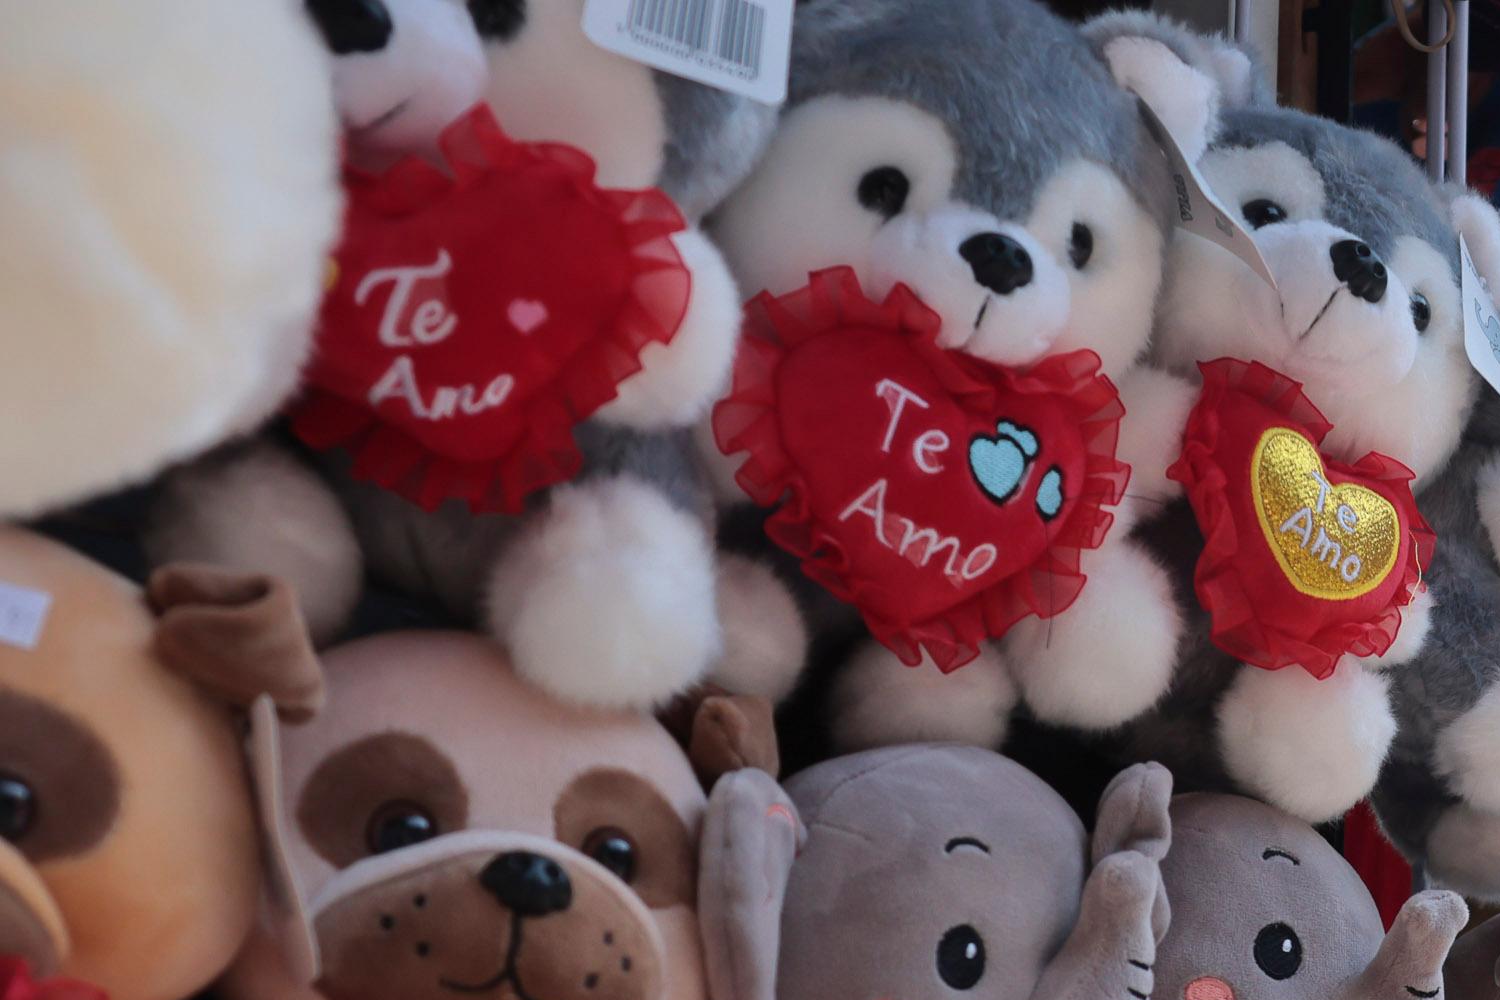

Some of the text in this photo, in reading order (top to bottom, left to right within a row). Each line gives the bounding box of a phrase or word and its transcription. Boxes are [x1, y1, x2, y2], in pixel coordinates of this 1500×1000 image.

[354, 247, 458, 347] Te
[368, 356, 514, 421] Amo
[875, 378, 950, 474] Te
[838, 478, 998, 580] Amo
[1311, 469, 1358, 533] Te
[1279, 507, 1361, 582] Amo
